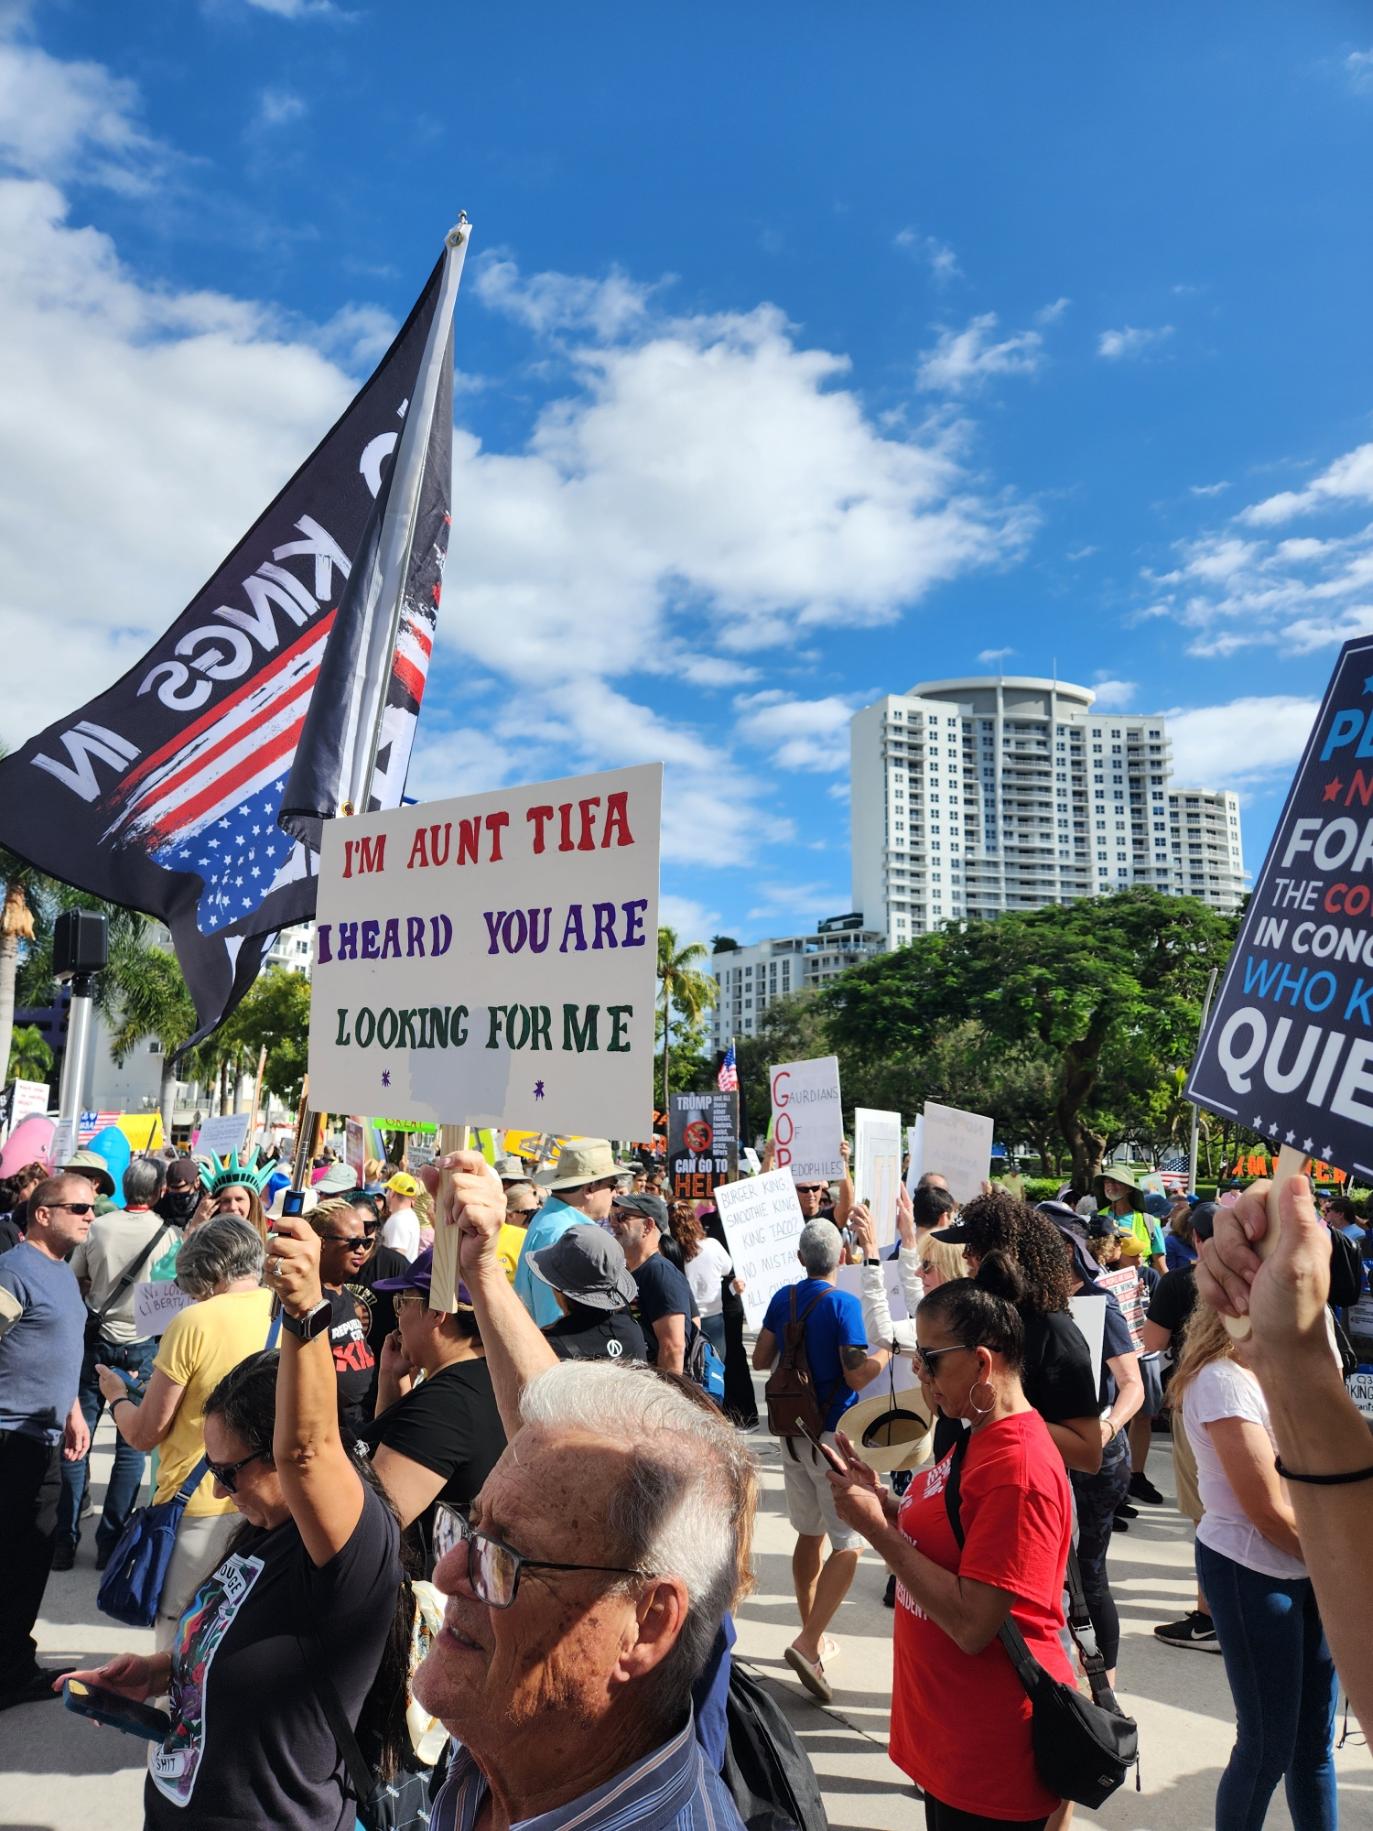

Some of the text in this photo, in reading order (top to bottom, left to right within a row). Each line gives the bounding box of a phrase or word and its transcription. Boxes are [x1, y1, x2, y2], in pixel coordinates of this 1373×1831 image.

[342, 791, 636, 878] I'M AUNT TIFA
[1271, 878, 1373, 917] THE CO
[337, 914, 453, 960] HEARD
[483, 907, 553, 954] YOU
[559, 899, 649, 953] ARE
[1253, 916, 1288, 950] IN
[1242, 956, 1338, 1013] WHO
[335, 1003, 634, 1052] LOOKING FOR ME
[677, 1095, 713, 1111] TRUMP
[675, 1159, 728, 1173] CAN GO TO
[742, 1228, 765, 1249] KING
